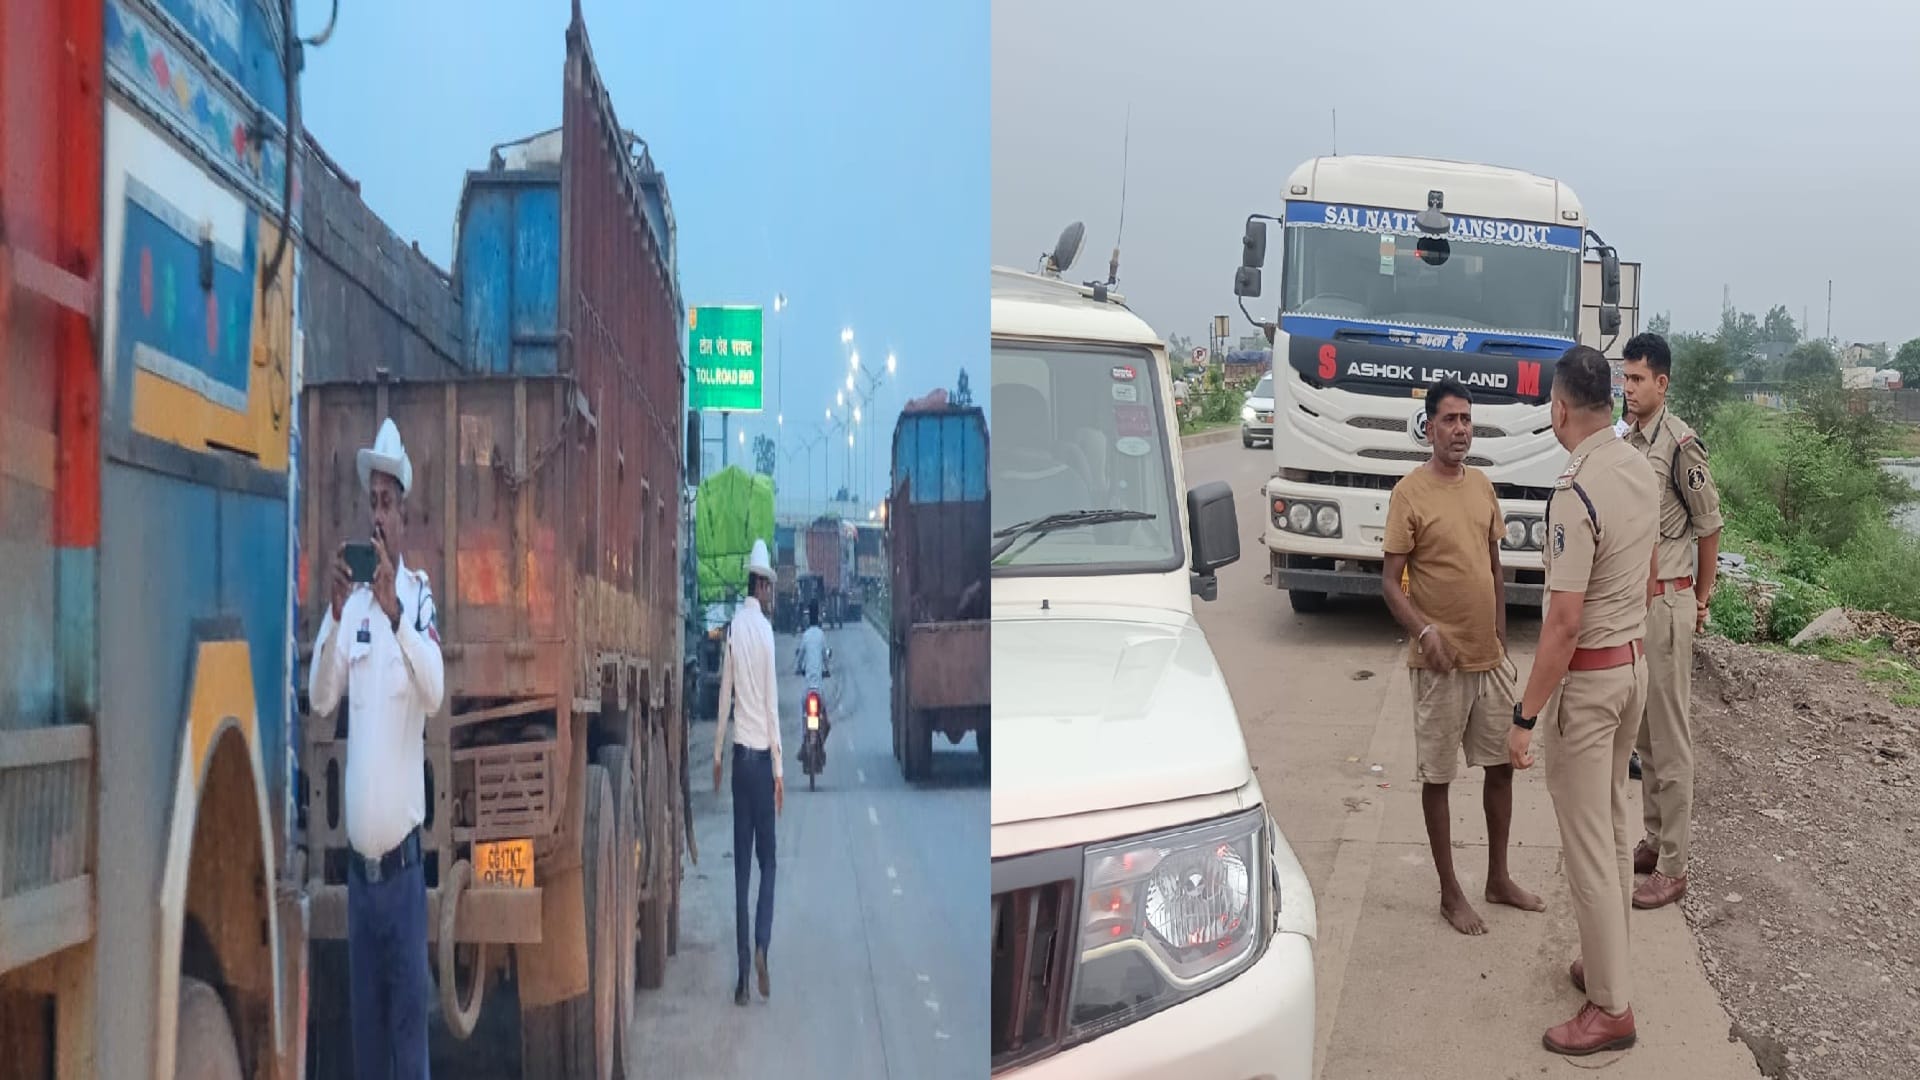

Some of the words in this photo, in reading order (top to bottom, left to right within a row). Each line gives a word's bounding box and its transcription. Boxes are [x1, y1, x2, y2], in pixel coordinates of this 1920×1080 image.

[1324, 205, 1359, 227] SAI
[1447, 217, 1550, 243] RANSPORT
[695, 367, 715, 385] TOLL
[1318, 343, 1337, 379] S
[1347, 361, 1414, 380] ASHOK
[1421, 367, 1508, 389] LEYLAND
[1516, 360, 1541, 397] M
